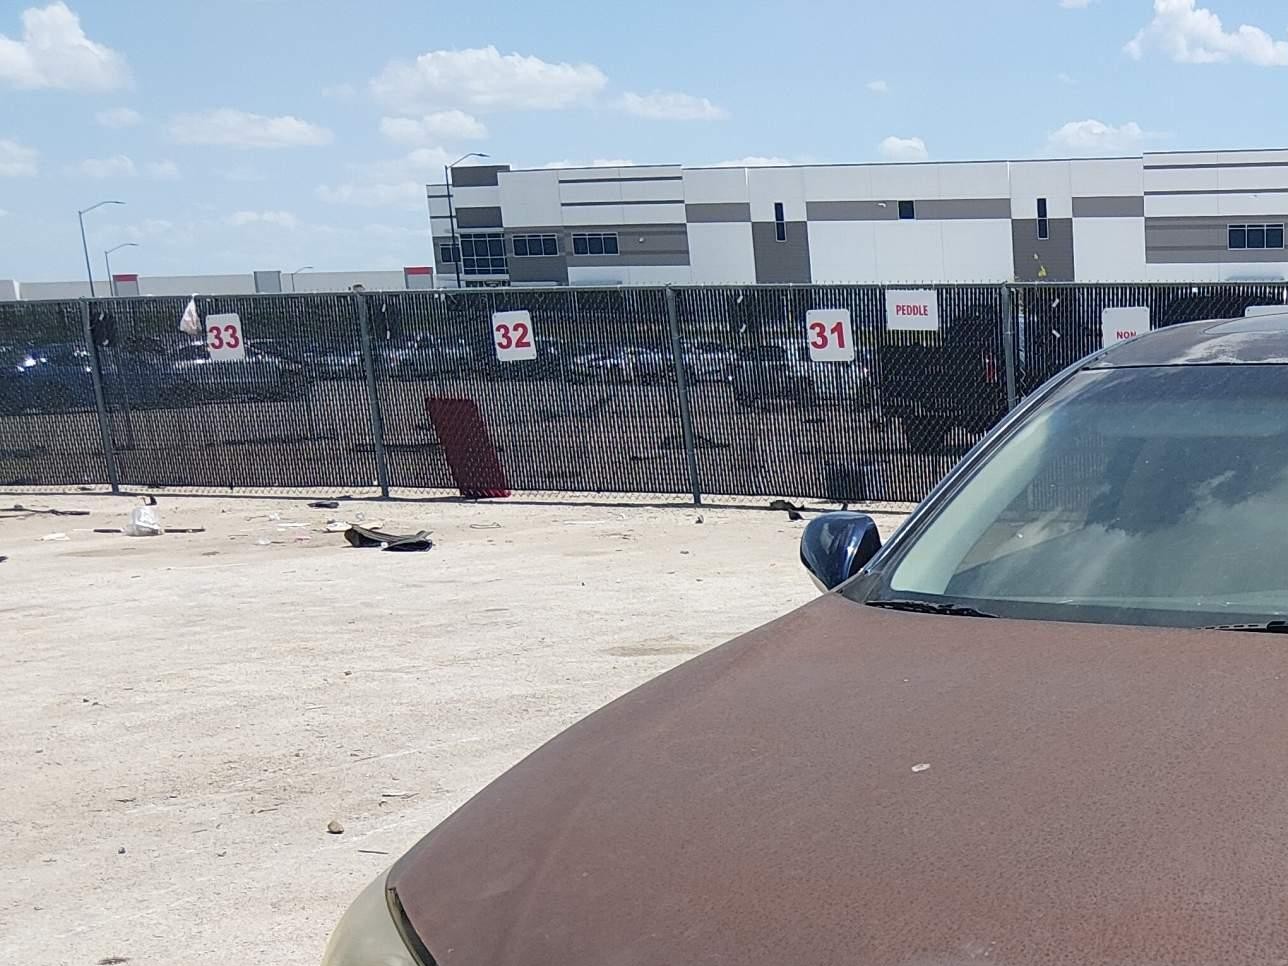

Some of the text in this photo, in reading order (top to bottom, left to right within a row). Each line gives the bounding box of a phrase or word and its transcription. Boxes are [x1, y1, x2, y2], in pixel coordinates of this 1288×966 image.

[896, 304, 929, 316] PEDDLE
[209, 325, 240, 350] 33
[495, 322, 531, 350] 32
[809, 321, 846, 350] 31
